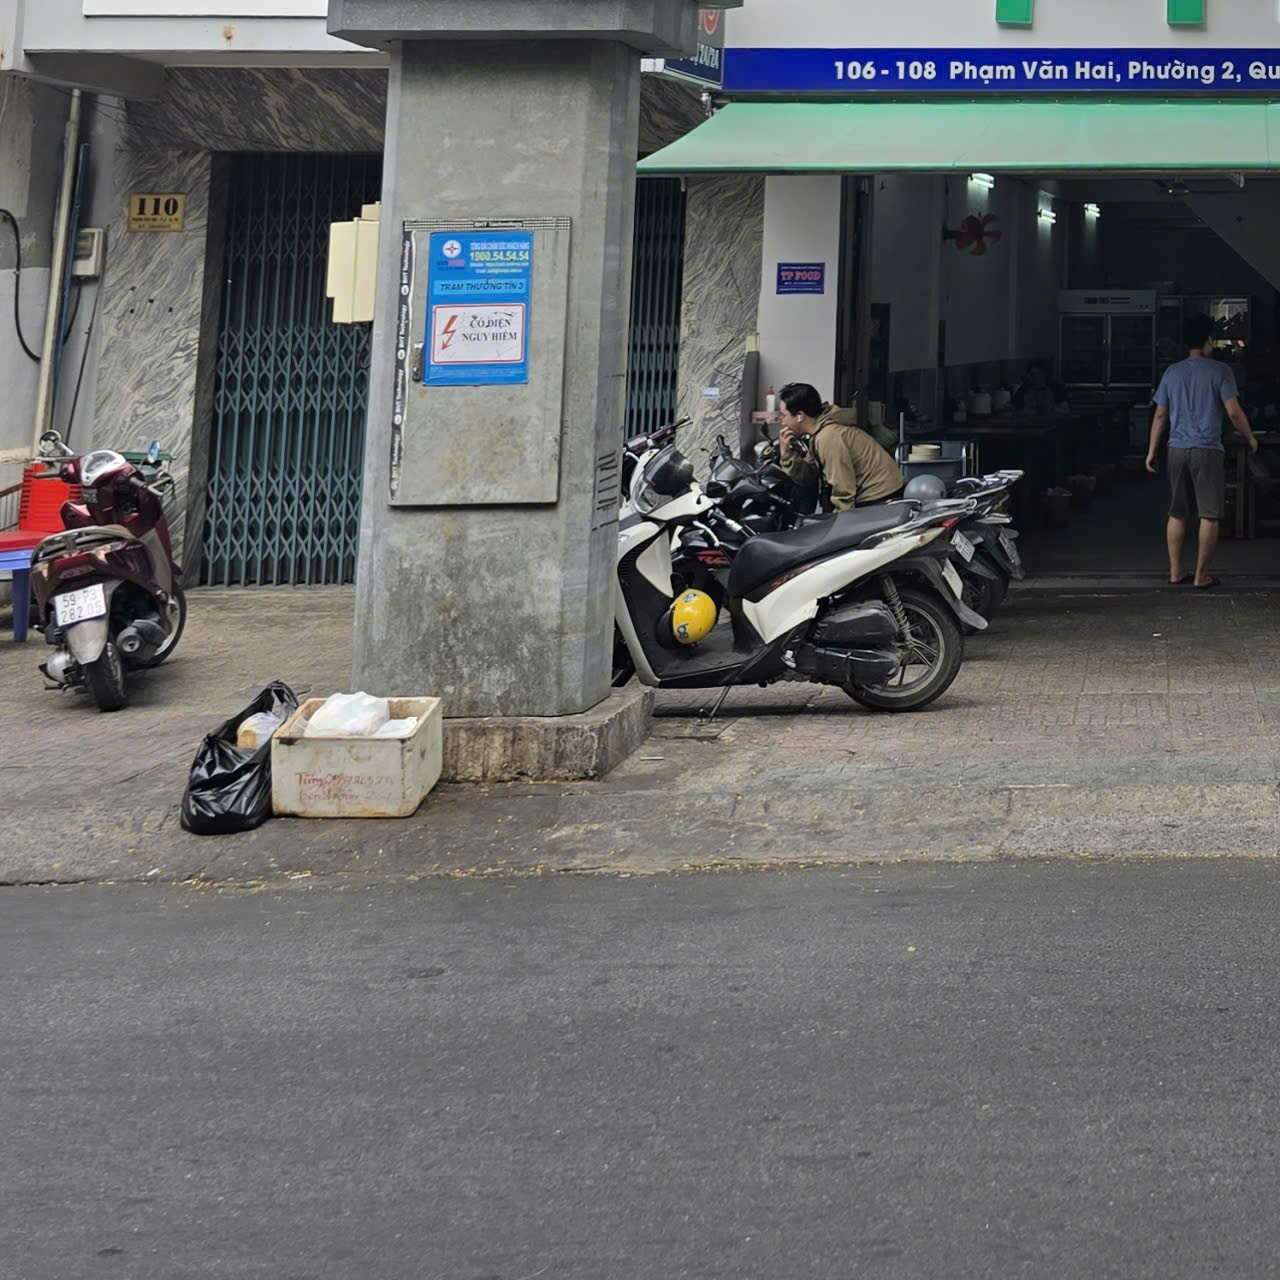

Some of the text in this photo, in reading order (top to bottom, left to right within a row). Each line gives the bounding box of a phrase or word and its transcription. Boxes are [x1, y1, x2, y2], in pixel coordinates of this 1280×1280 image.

[834, 61, 876, 80] 106
[896, 61, 936, 80] 108
[950, 61, 1016, 84] Phạm
[1022, 60, 1068, 80] Văn
[1075, 61, 1121, 83] Hai,
[1128, 59, 1215, 84] Phường
[1221, 61, 1242, 83] 2,
[136, 198, 179, 217] 110
[470, 250, 529, 261] 1900.54.54.54
[462, 332, 491, 342] NGUY
